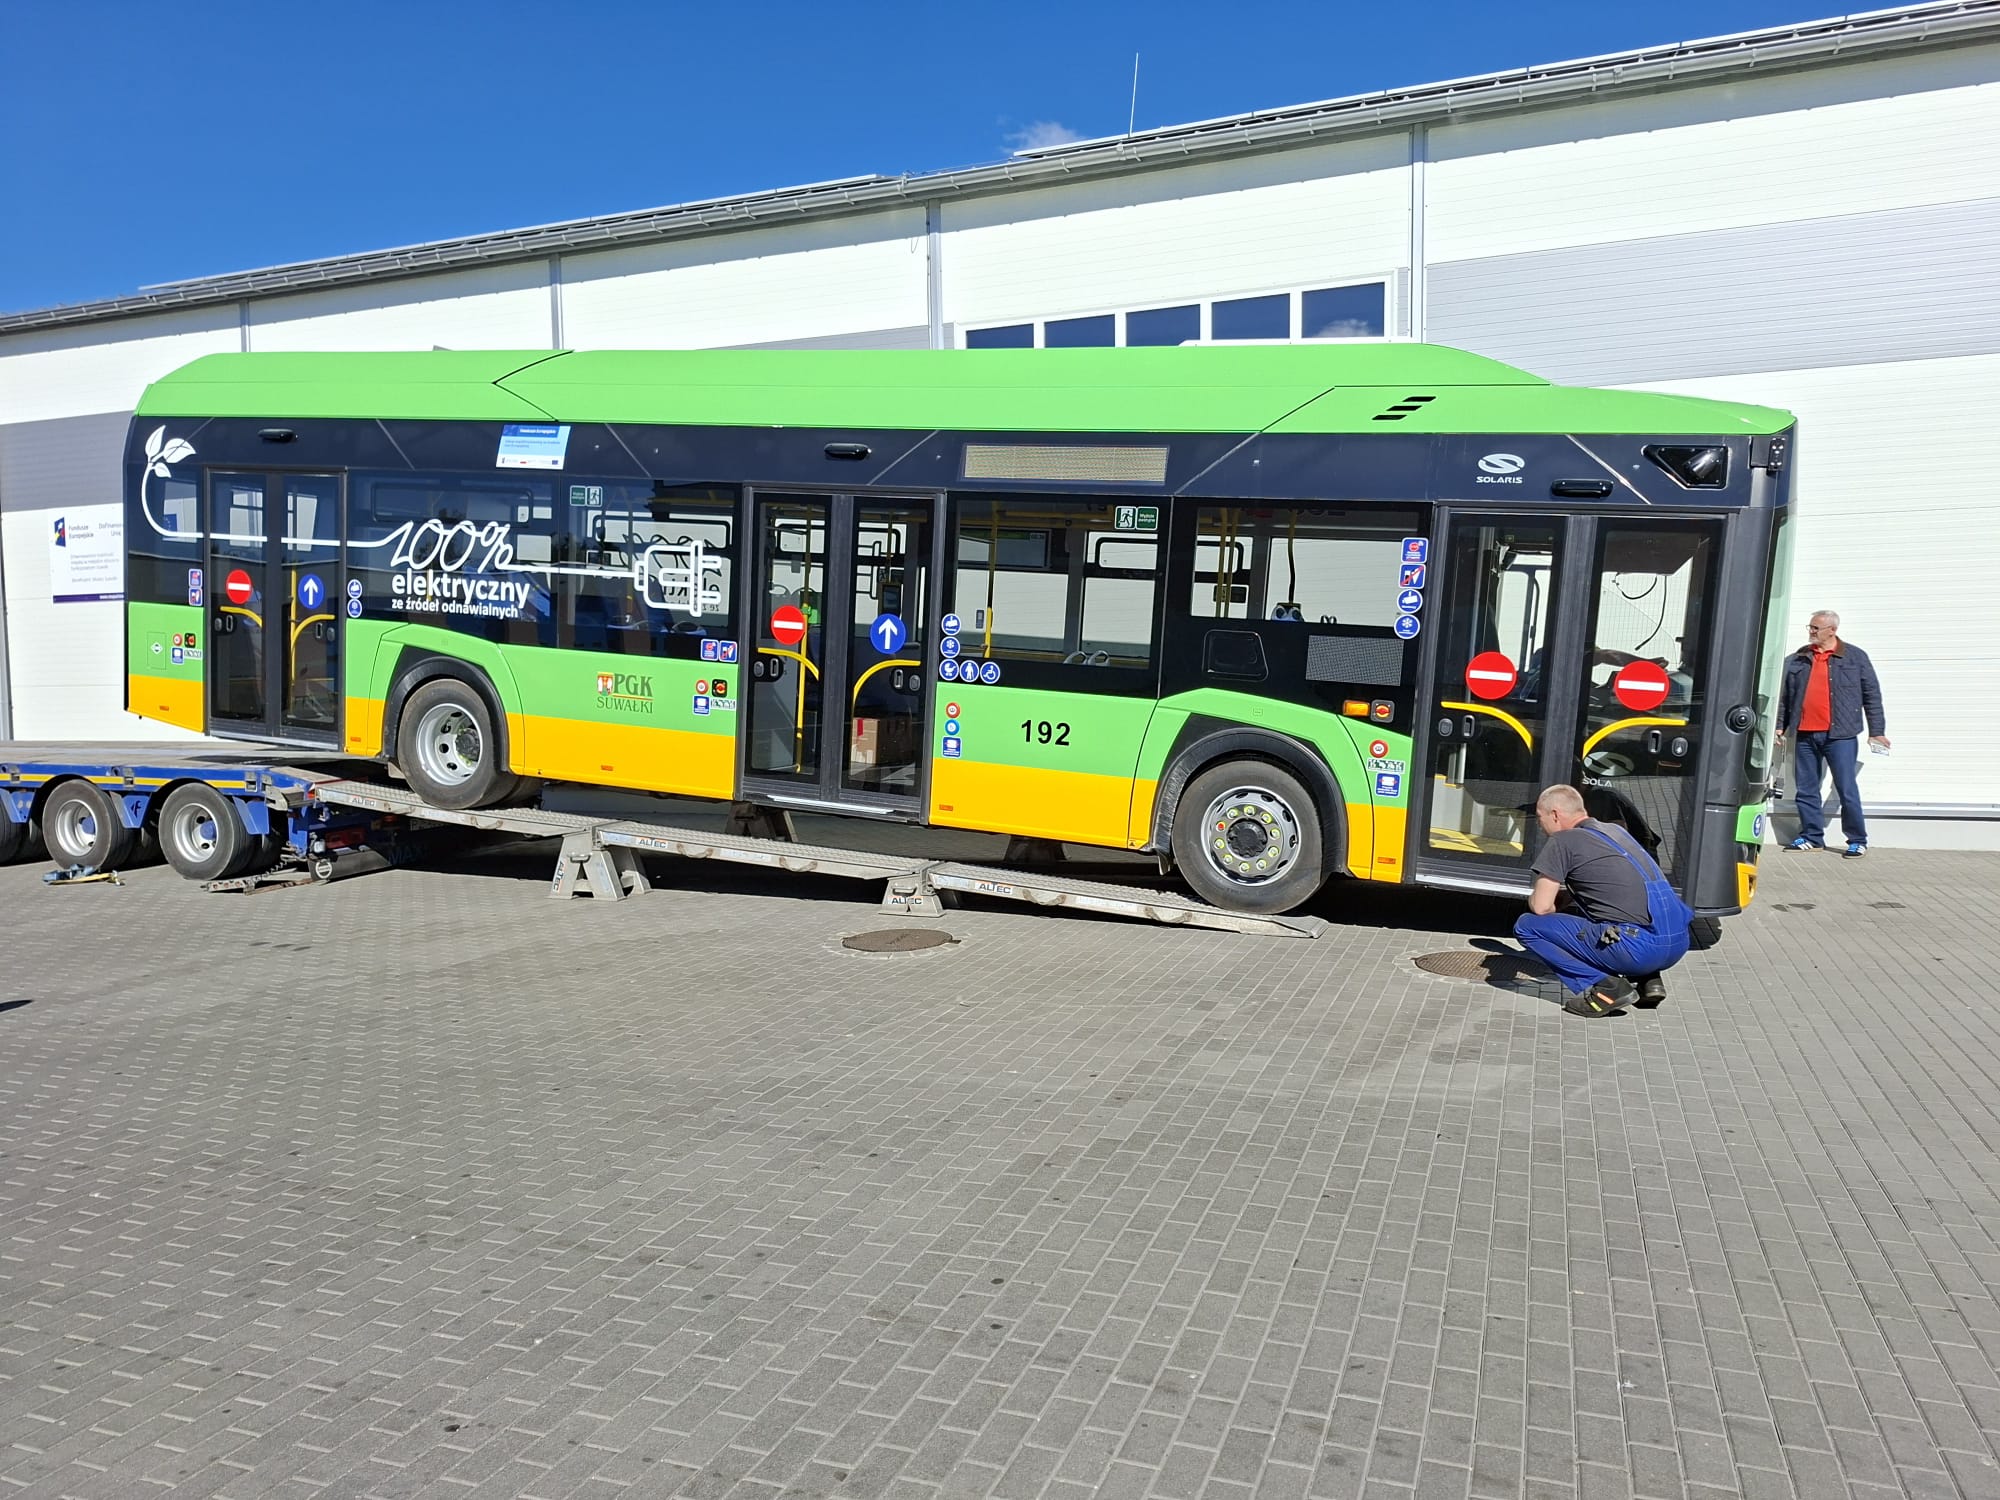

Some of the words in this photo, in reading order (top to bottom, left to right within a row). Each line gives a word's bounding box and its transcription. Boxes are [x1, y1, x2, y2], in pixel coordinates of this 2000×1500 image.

[1476, 476, 1523, 484] SOLARIS
[390, 519, 514, 574] 100%
[391, 567, 531, 609] elektryczny
[391, 598, 404, 609] ze
[405, 596, 439, 612] źródeł
[441, 600, 519, 620] odnawialnych
[614, 673, 653, 698] PGK
[596, 696, 654, 714] SUWAŁKI
[1021, 719, 1071, 746] 192
[1582, 776, 1613, 788] SOLA
[639, 837, 667, 849] ALTEC
[554, 860, 565, 892] ALTEC
[978, 881, 1011, 894] ALTEC
[891, 896, 923, 905] ALTEC
